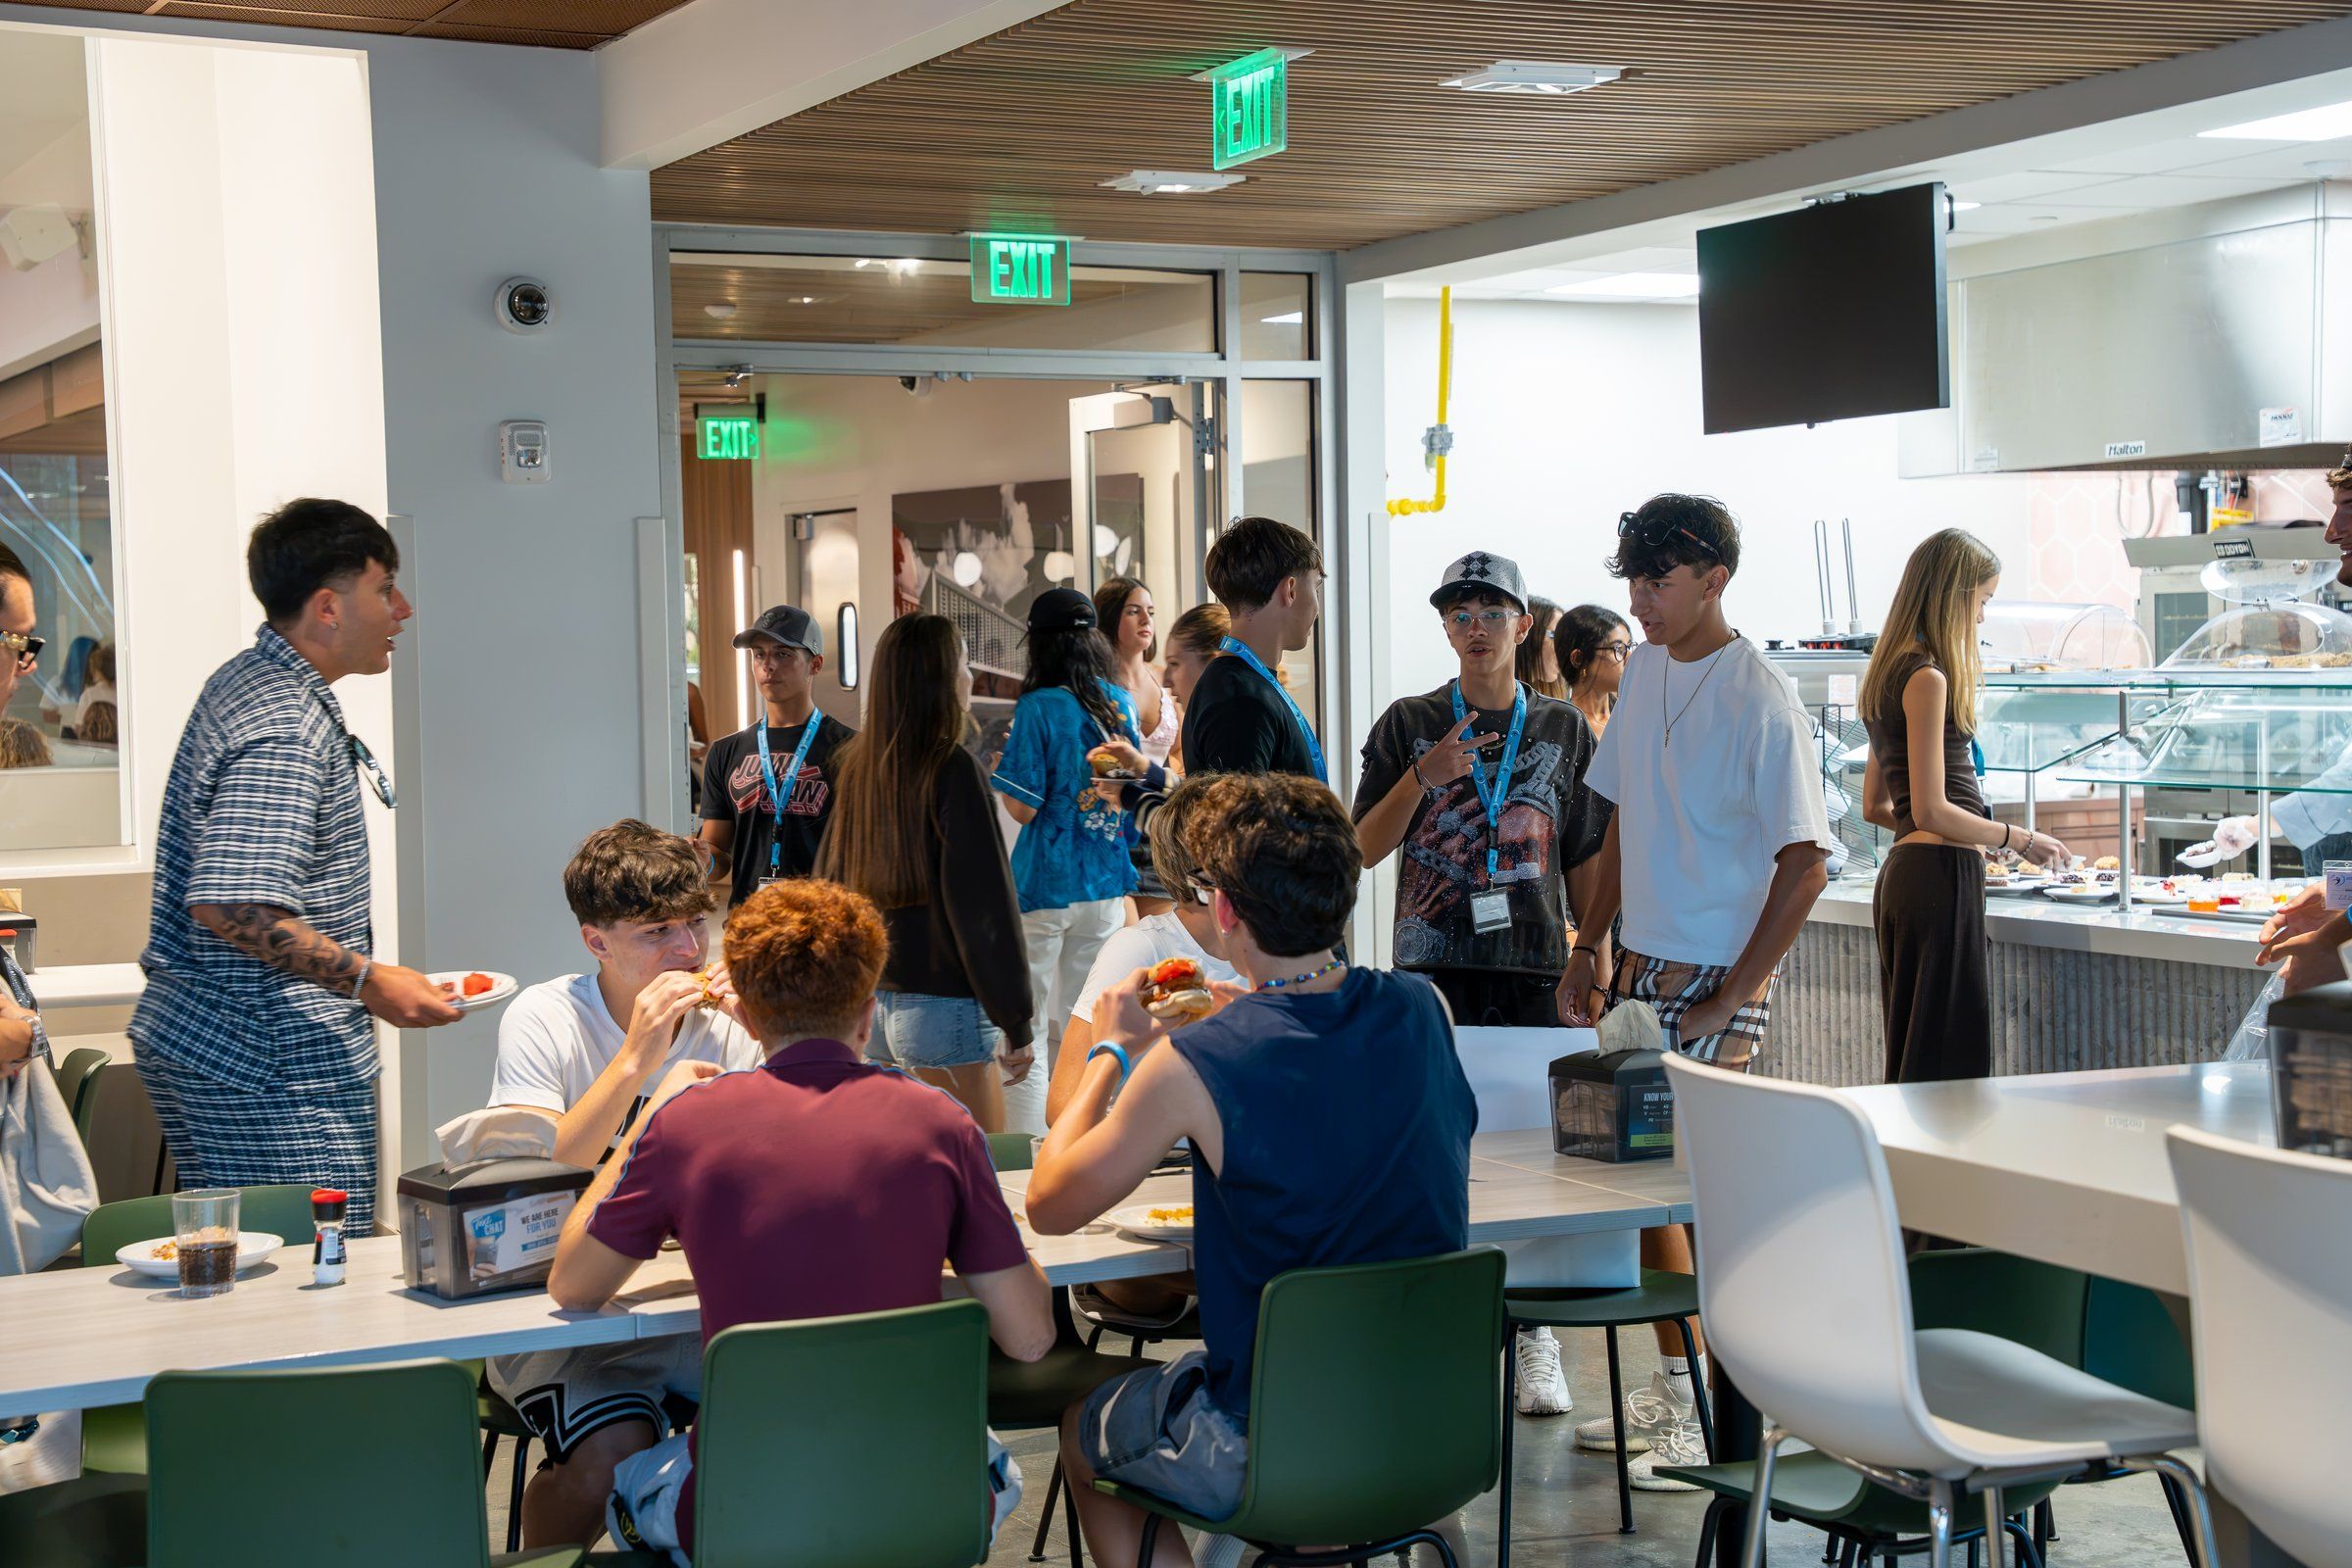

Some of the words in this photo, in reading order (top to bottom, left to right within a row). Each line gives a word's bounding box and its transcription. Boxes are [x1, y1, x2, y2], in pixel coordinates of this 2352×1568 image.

[1227, 66, 1274, 158] EXIT
[990, 240, 1055, 299] EXIT
[707, 420, 751, 458] EXIT
[2109, 443, 2143, 456] Halton
[1643, 1092, 1660, 1102] KNOW
[520, 1215, 531, 1224] WE
[531, 1211, 544, 1222] ARE
[544, 1207, 559, 1219] HERE
[526, 1223, 542, 1234] FOR
[542, 1217, 557, 1230] YOU
